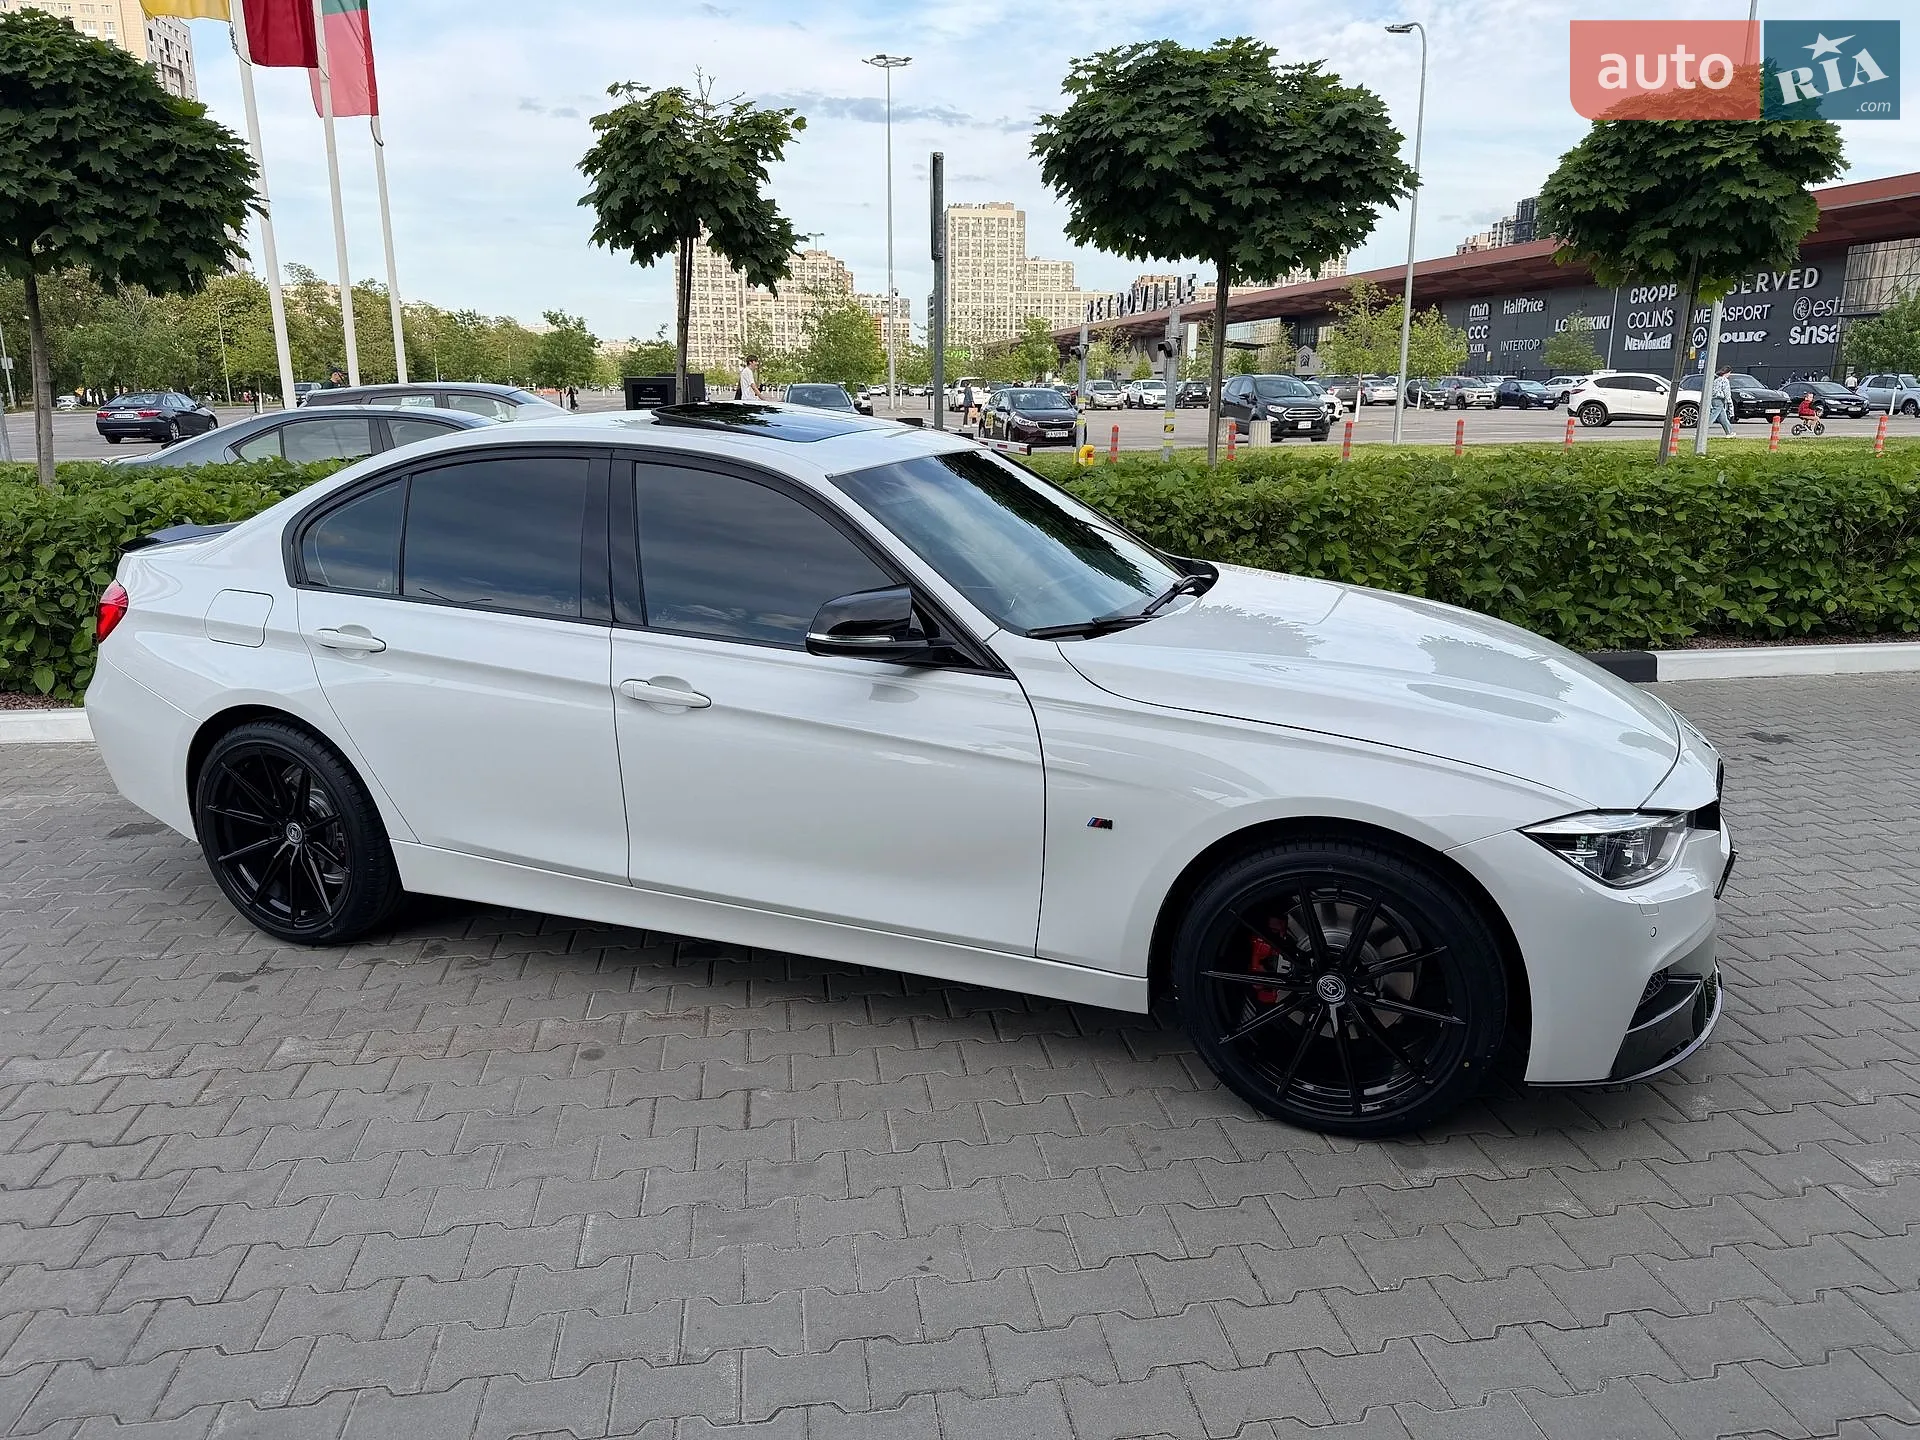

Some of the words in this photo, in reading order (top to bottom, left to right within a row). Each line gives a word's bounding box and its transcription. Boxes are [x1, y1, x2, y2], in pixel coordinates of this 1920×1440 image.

[1630, 284, 1678, 304] CROPP
[1469, 303, 1489, 317] min
[1503, 297, 1544, 315] HalfPrice
[1693, 304, 1771, 324] MEASPORT
[1627, 307, 1674, 329] COLIN'S
[1469, 325, 1489, 340] CCC
[1719, 330, 1767, 344] ouse
[1500, 338, 1541, 352] INTERTOP
